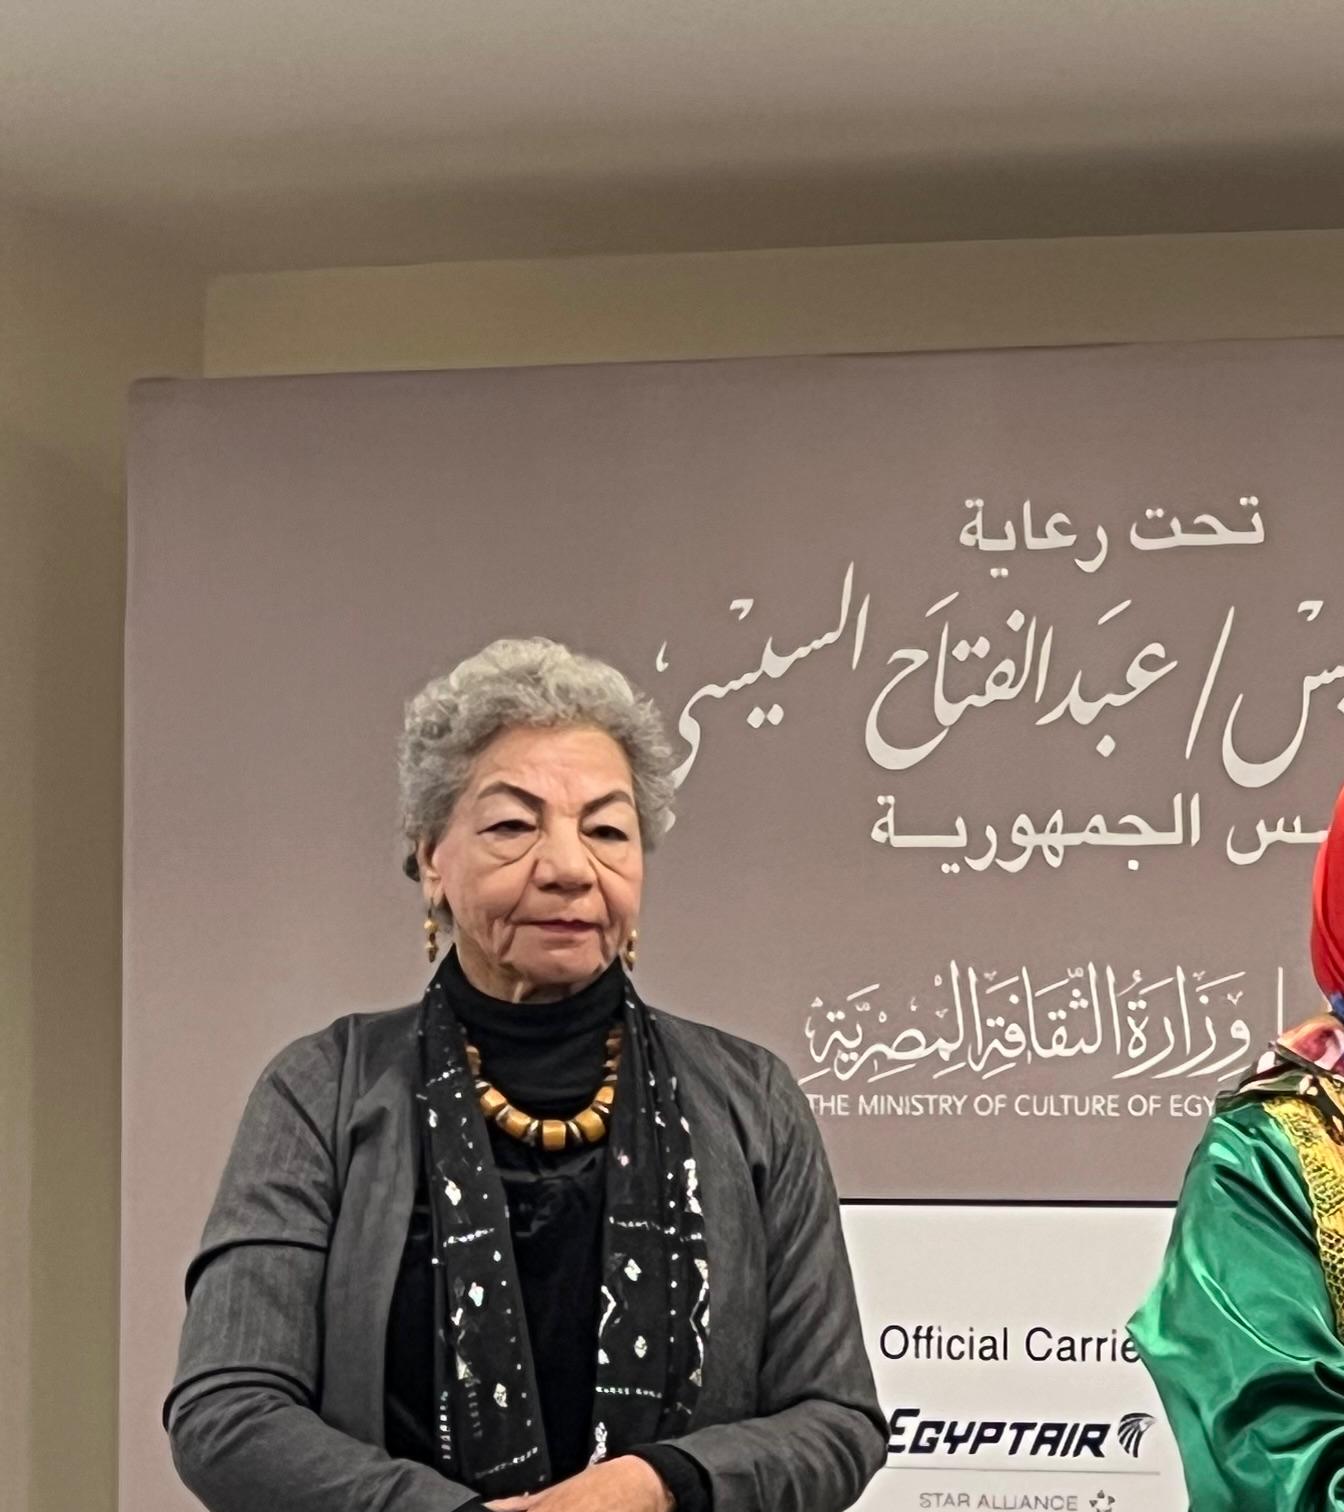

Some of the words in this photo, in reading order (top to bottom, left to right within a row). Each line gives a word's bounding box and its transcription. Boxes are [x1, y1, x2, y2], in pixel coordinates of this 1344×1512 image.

[959, 498, 1108, 578] رعاية
[1130, 496, 1265, 550] تحت
[871, 792, 1200, 874] الجمهورية
[806, 1093, 849, 1116] THE
[858, 1093, 969, 1117] MINISTRY
[973, 1094, 1006, 1116] OF
[1014, 1094, 1120, 1117] CULTURE
[1128, 1094, 1161, 1117] OF
[880, 1325, 1008, 1361] Official
[919, 1492, 971, 1509] STAR
[977, 1494, 1079, 1511] ALLIANCE
